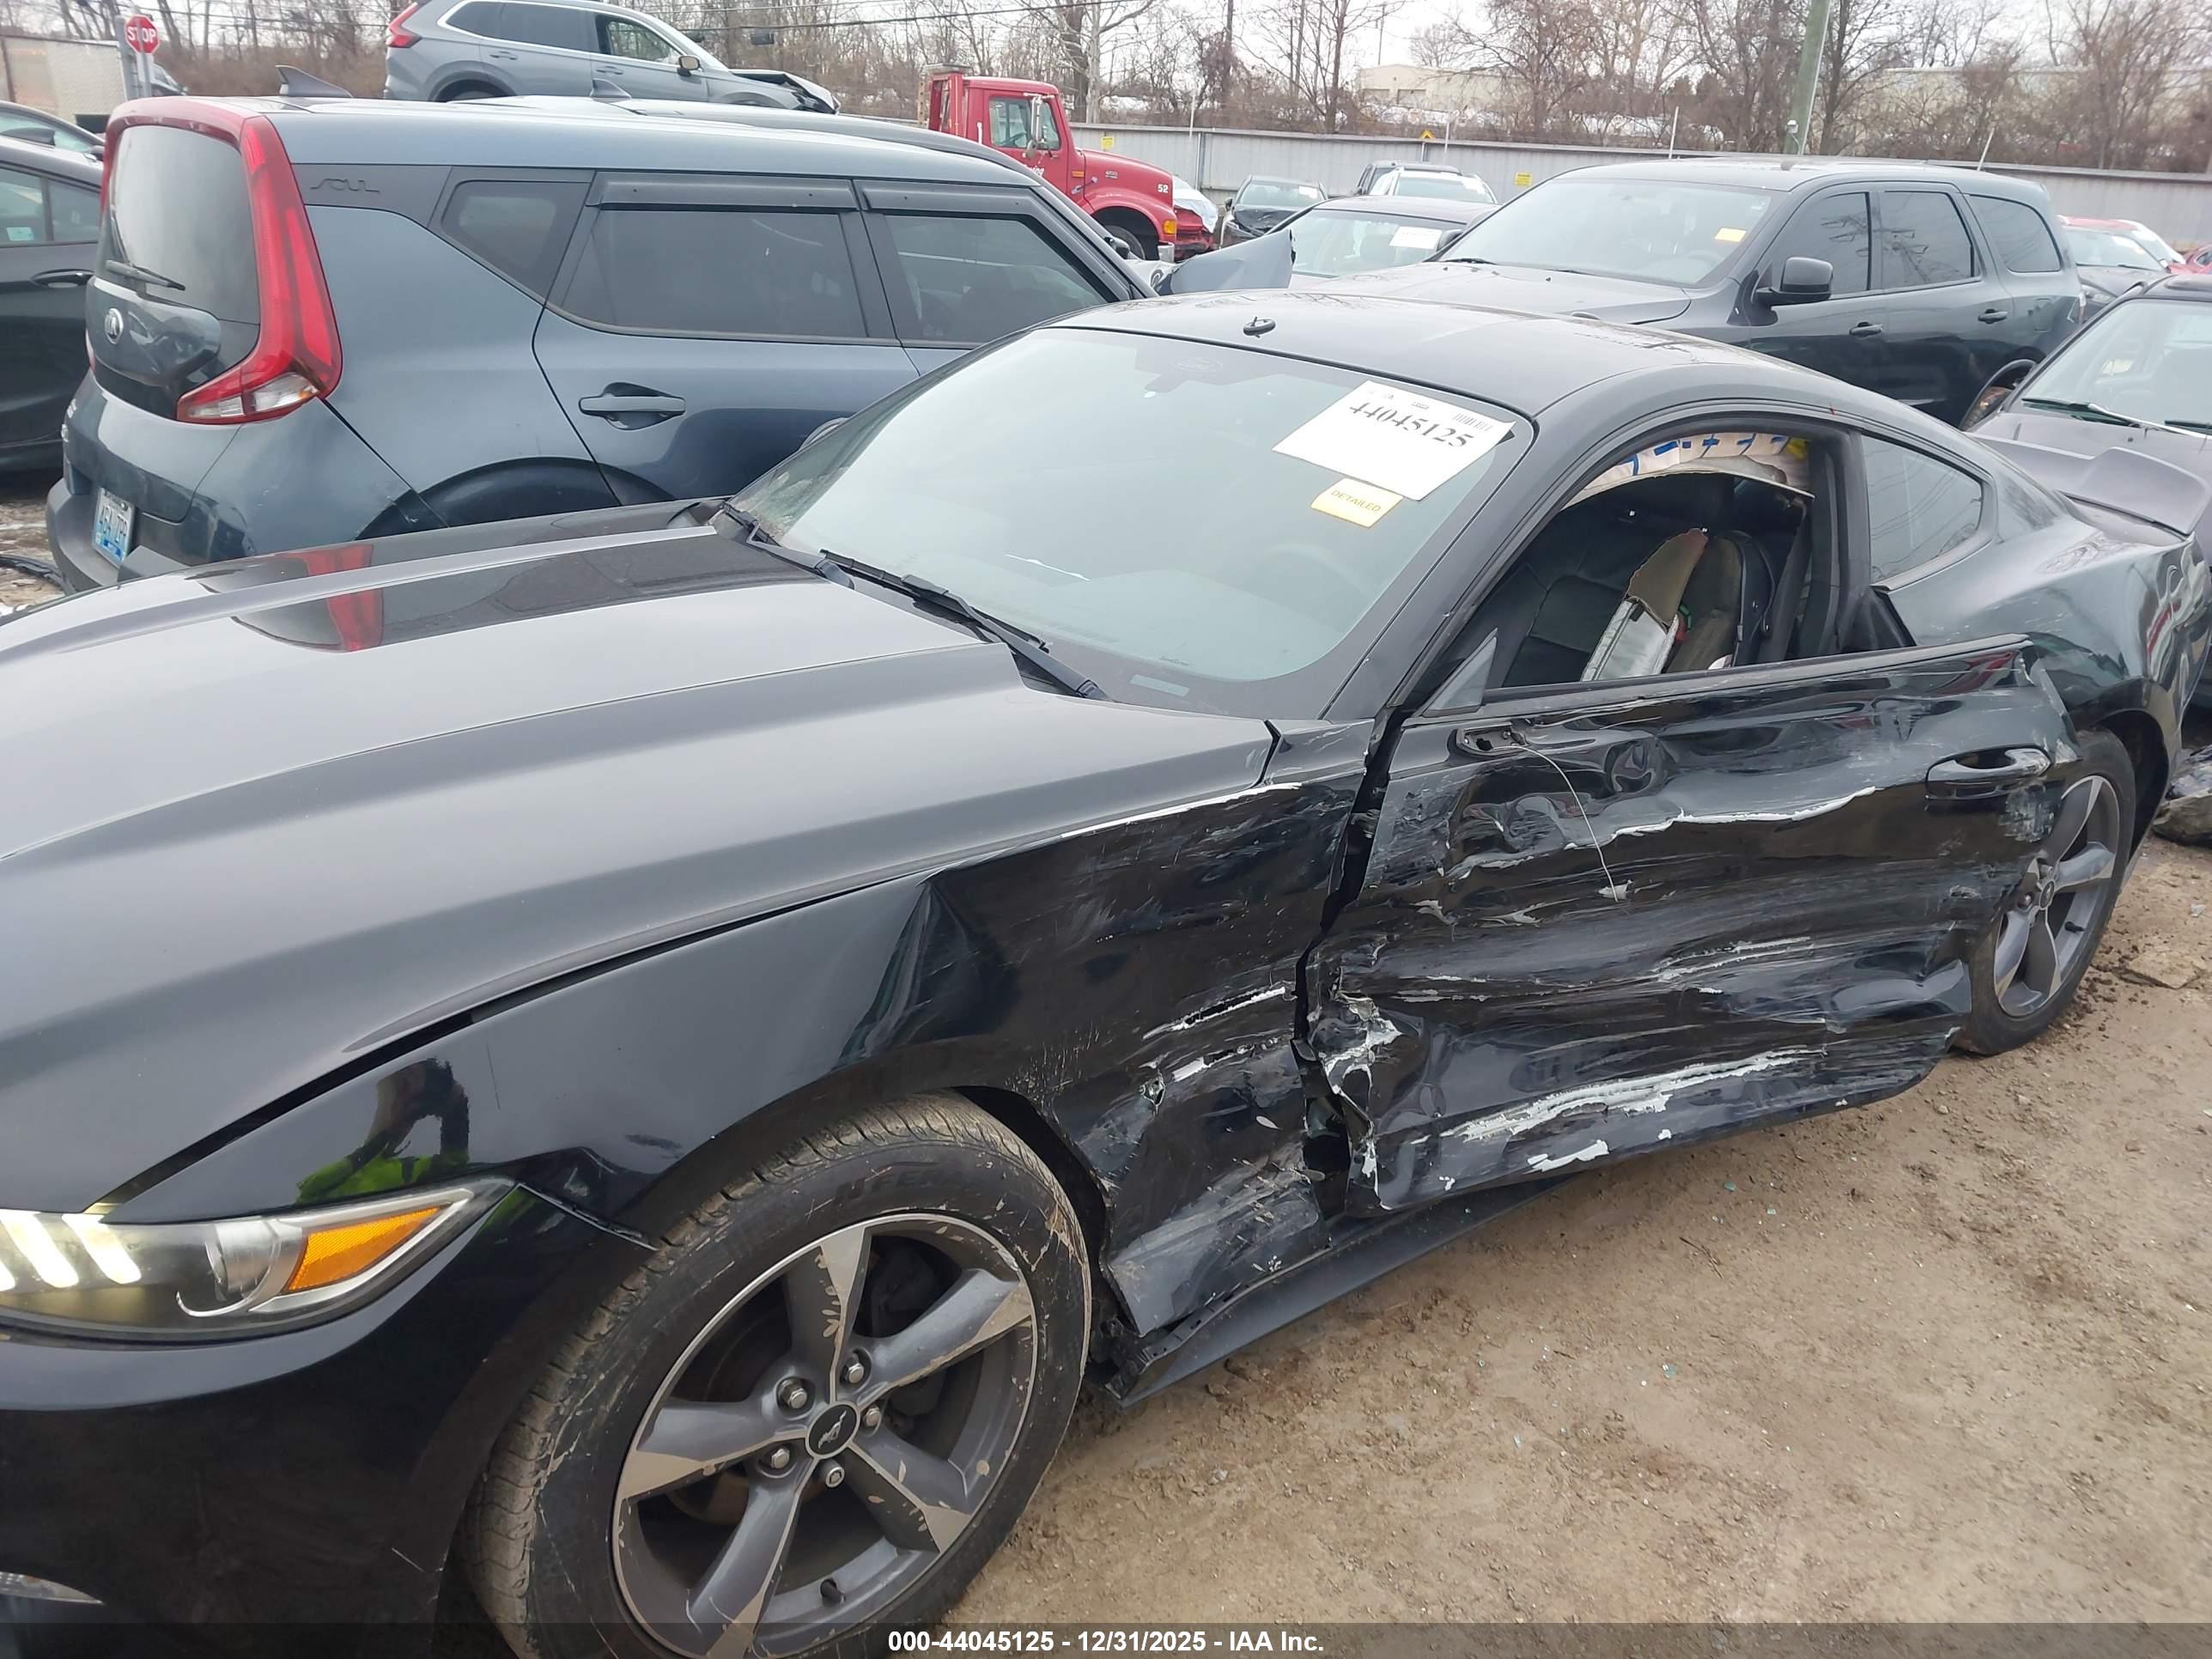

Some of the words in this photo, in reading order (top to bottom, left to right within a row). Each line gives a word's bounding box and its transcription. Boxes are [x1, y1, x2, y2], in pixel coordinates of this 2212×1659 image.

[310, 178, 380, 193] SOUL
[1158, 184, 1169, 193] 52
[1349, 401, 1475, 447] 44045125
[1331, 489, 1382, 513] DETAILED
